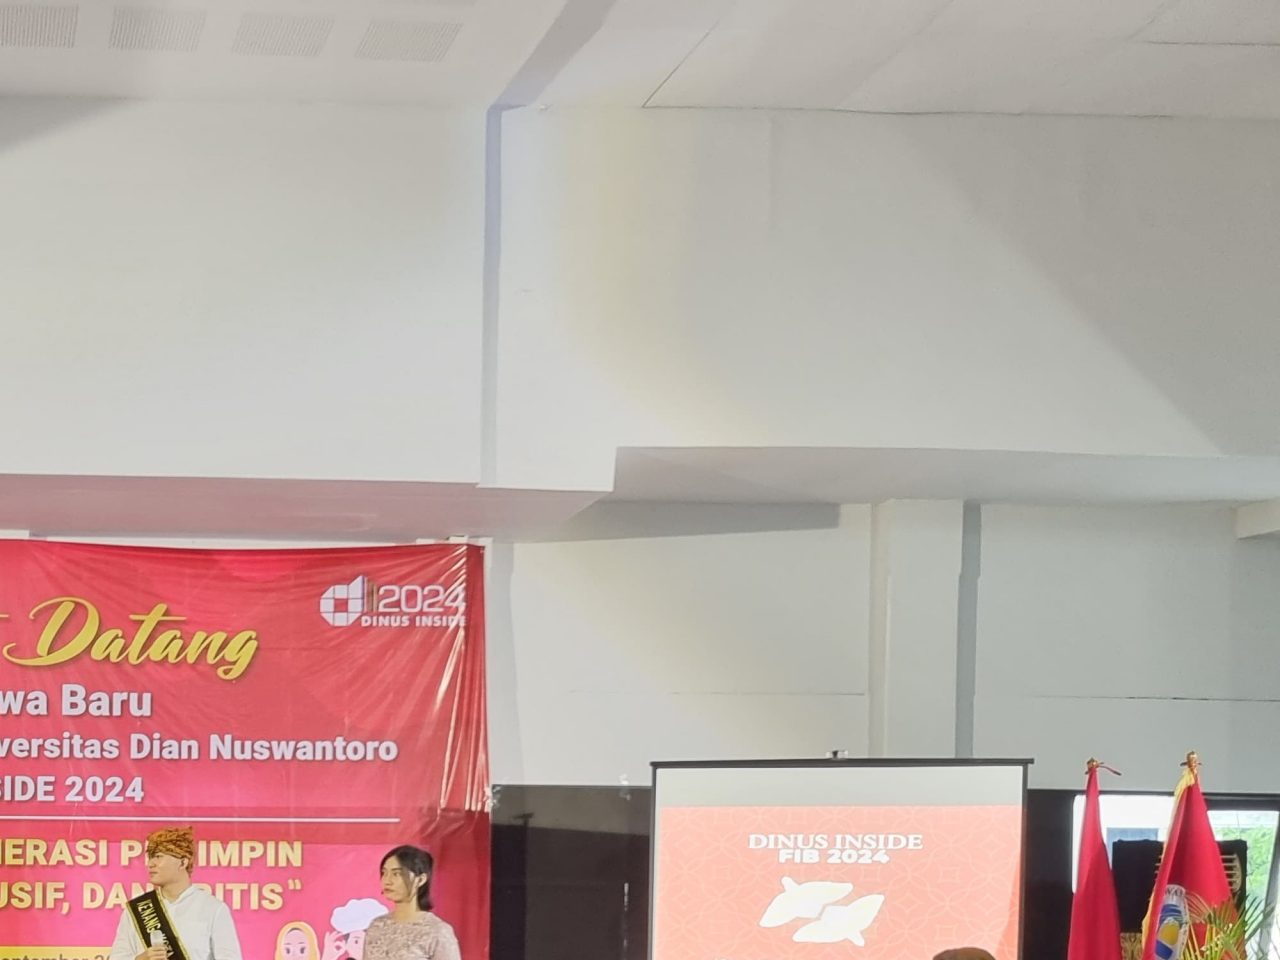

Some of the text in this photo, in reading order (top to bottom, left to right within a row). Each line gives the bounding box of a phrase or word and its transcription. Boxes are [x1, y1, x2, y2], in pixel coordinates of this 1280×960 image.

[378, 584, 466, 613] 2024
[361, 615, 467, 627] DINUS INSIDE
[2, 594, 259, 681] Datang
[61, 683, 152, 716] Baru
[129, 733, 200, 761] Dian
[209, 733, 398, 763] Nuswantoro
[64, 776, 145, 803] 2024
[121, 839, 303, 868] PIMPIN
[748, 833, 924, 850] DINUS INSIDE
[778, 849, 890, 865] FIB 2024
